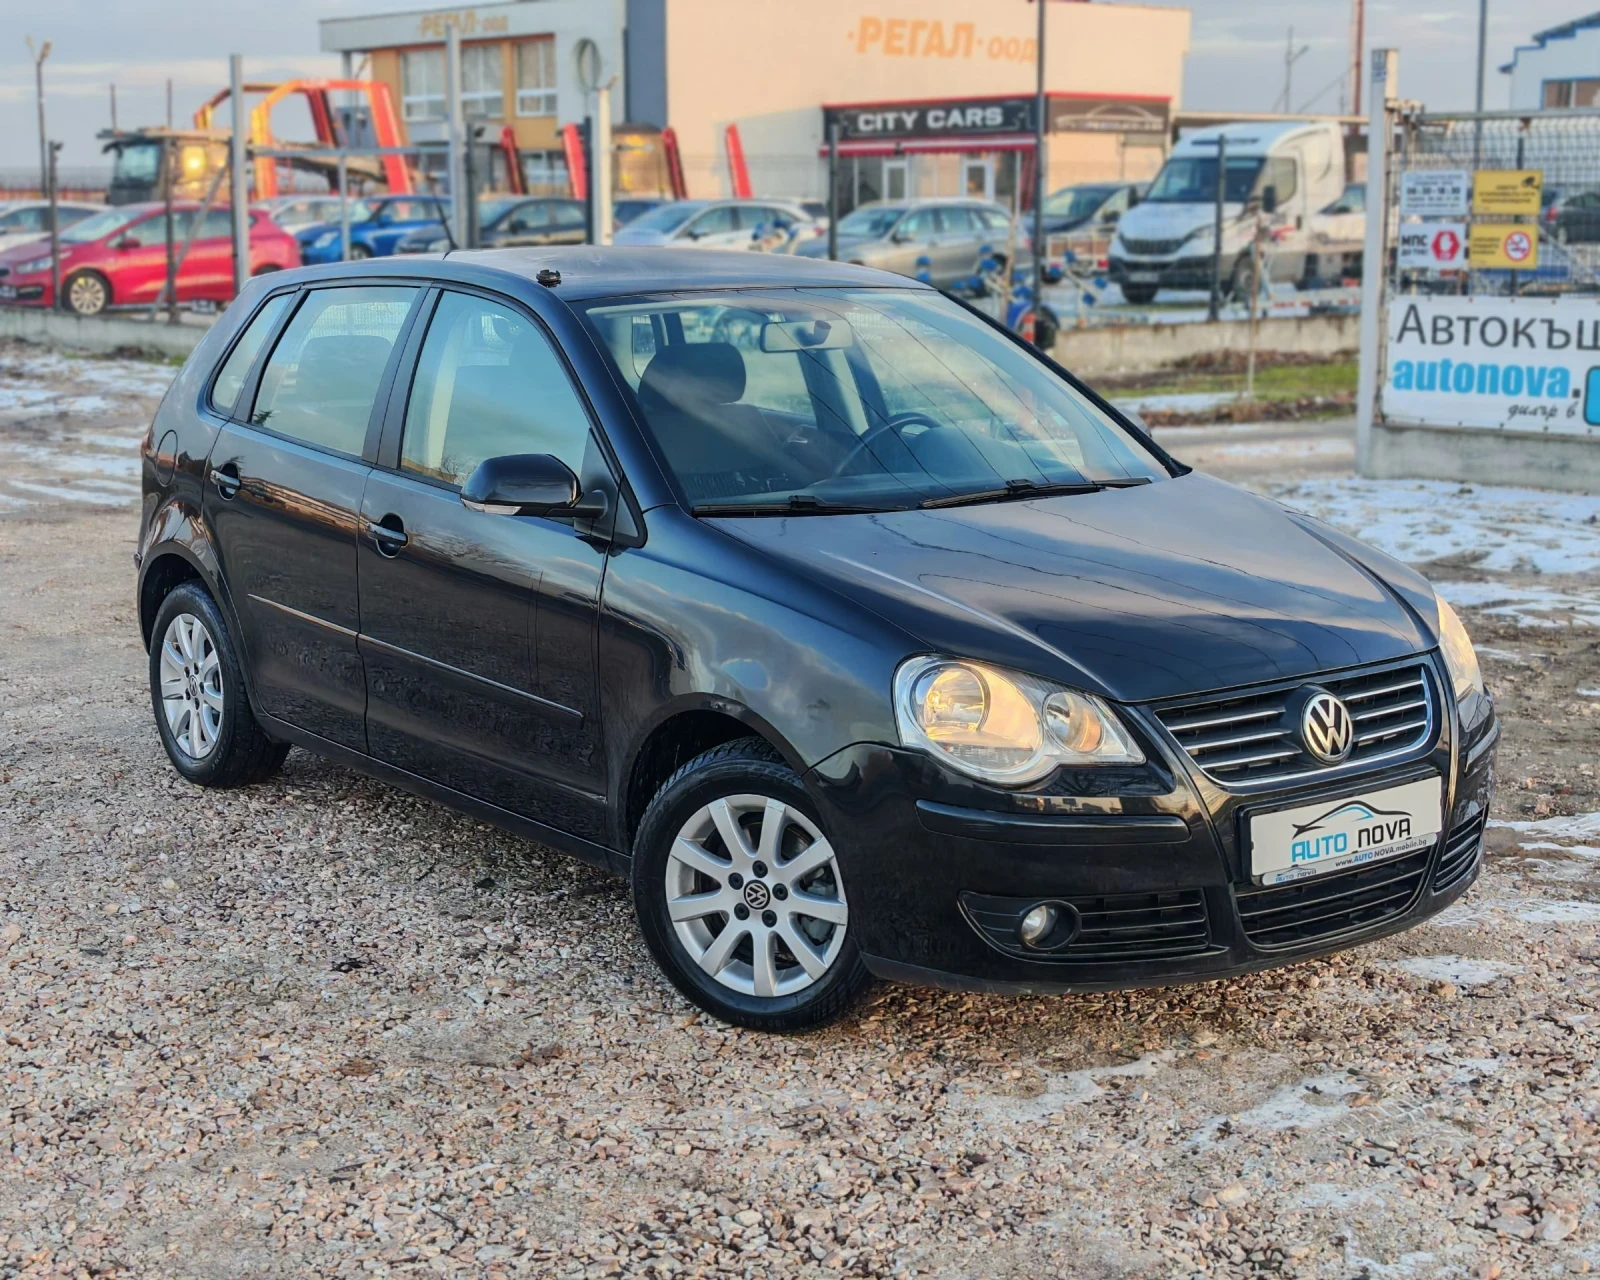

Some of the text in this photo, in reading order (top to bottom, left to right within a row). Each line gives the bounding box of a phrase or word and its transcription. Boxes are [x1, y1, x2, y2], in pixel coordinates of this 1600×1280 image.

[856, 16, 975, 59] РЕГАЛ
[857, 106, 1003, 132] CITY CARS
[1291, 818, 1411, 862] AUTO NOVA
